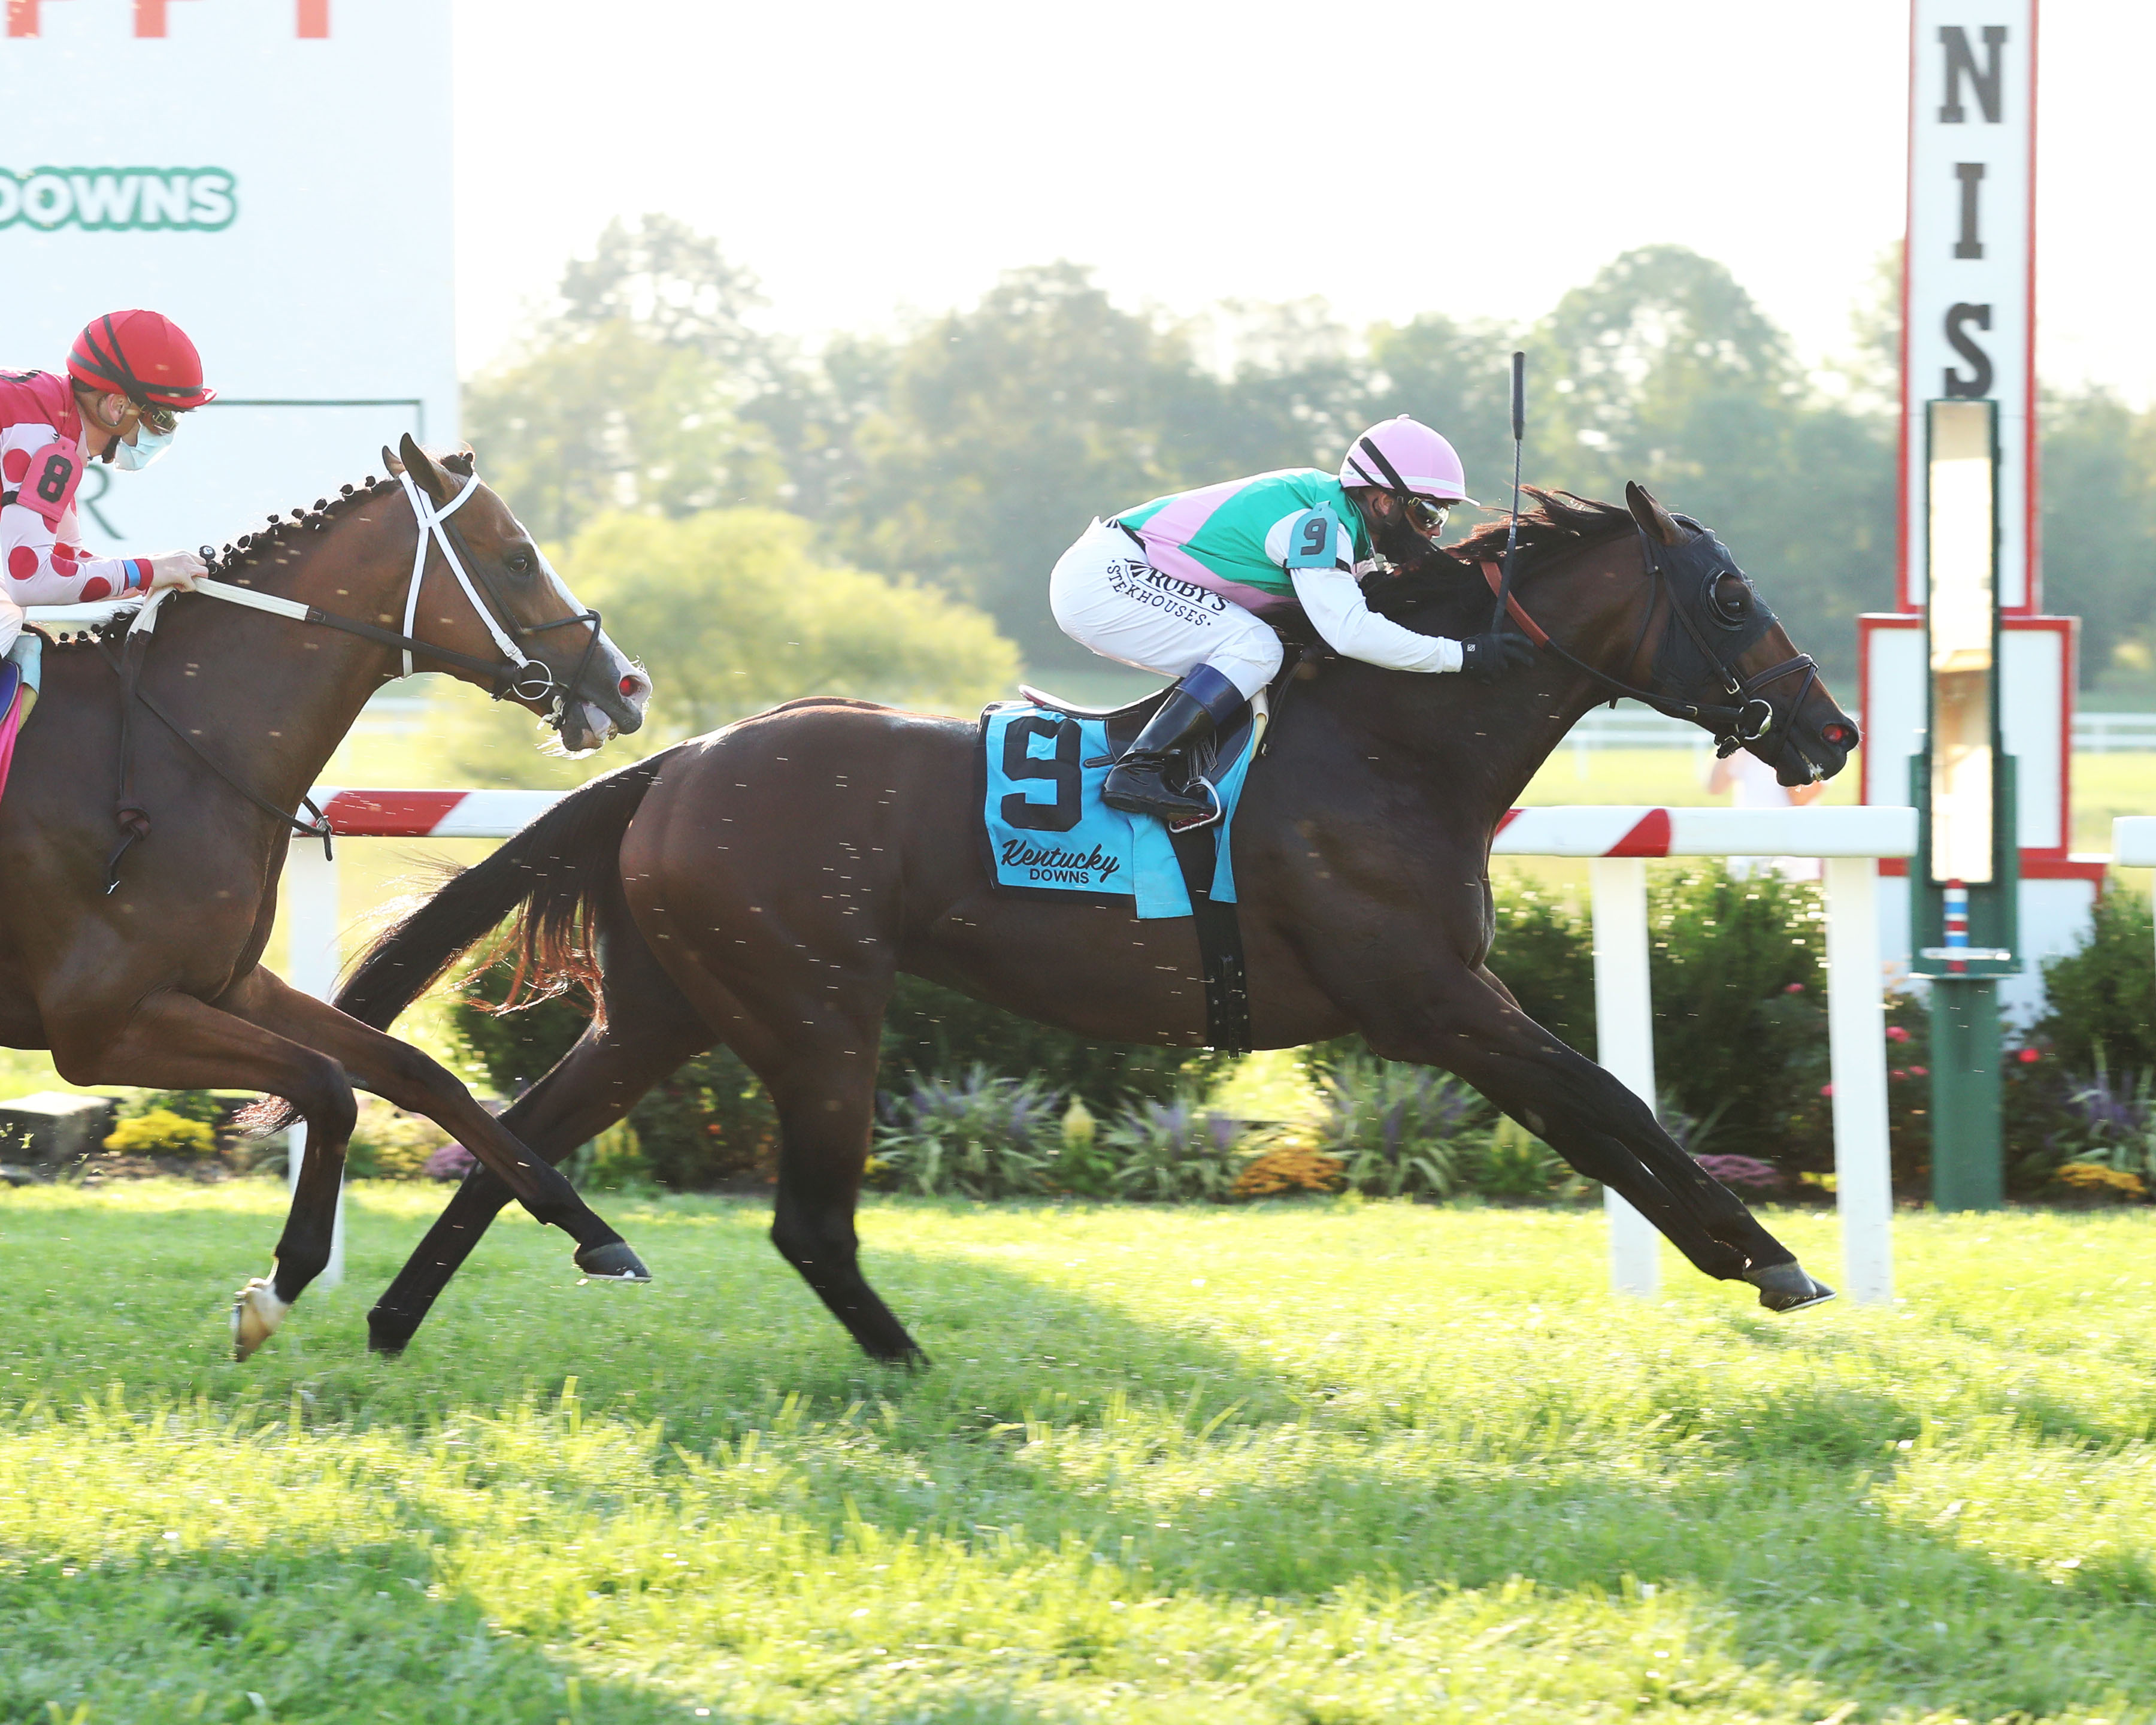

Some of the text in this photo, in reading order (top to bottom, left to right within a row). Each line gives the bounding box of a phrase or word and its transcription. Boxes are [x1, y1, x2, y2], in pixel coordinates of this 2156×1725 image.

[37, 454, 72, 503] 8
[1301, 518, 1327, 556] 9
[1107, 565, 1207, 626] STEKHOUSES
[1144, 569, 1231, 611] RUBY'S
[1001, 716, 1082, 832] 9
[1001, 839, 1120, 883] Kentucky
[1029, 868, 1089, 884] DOWNS
